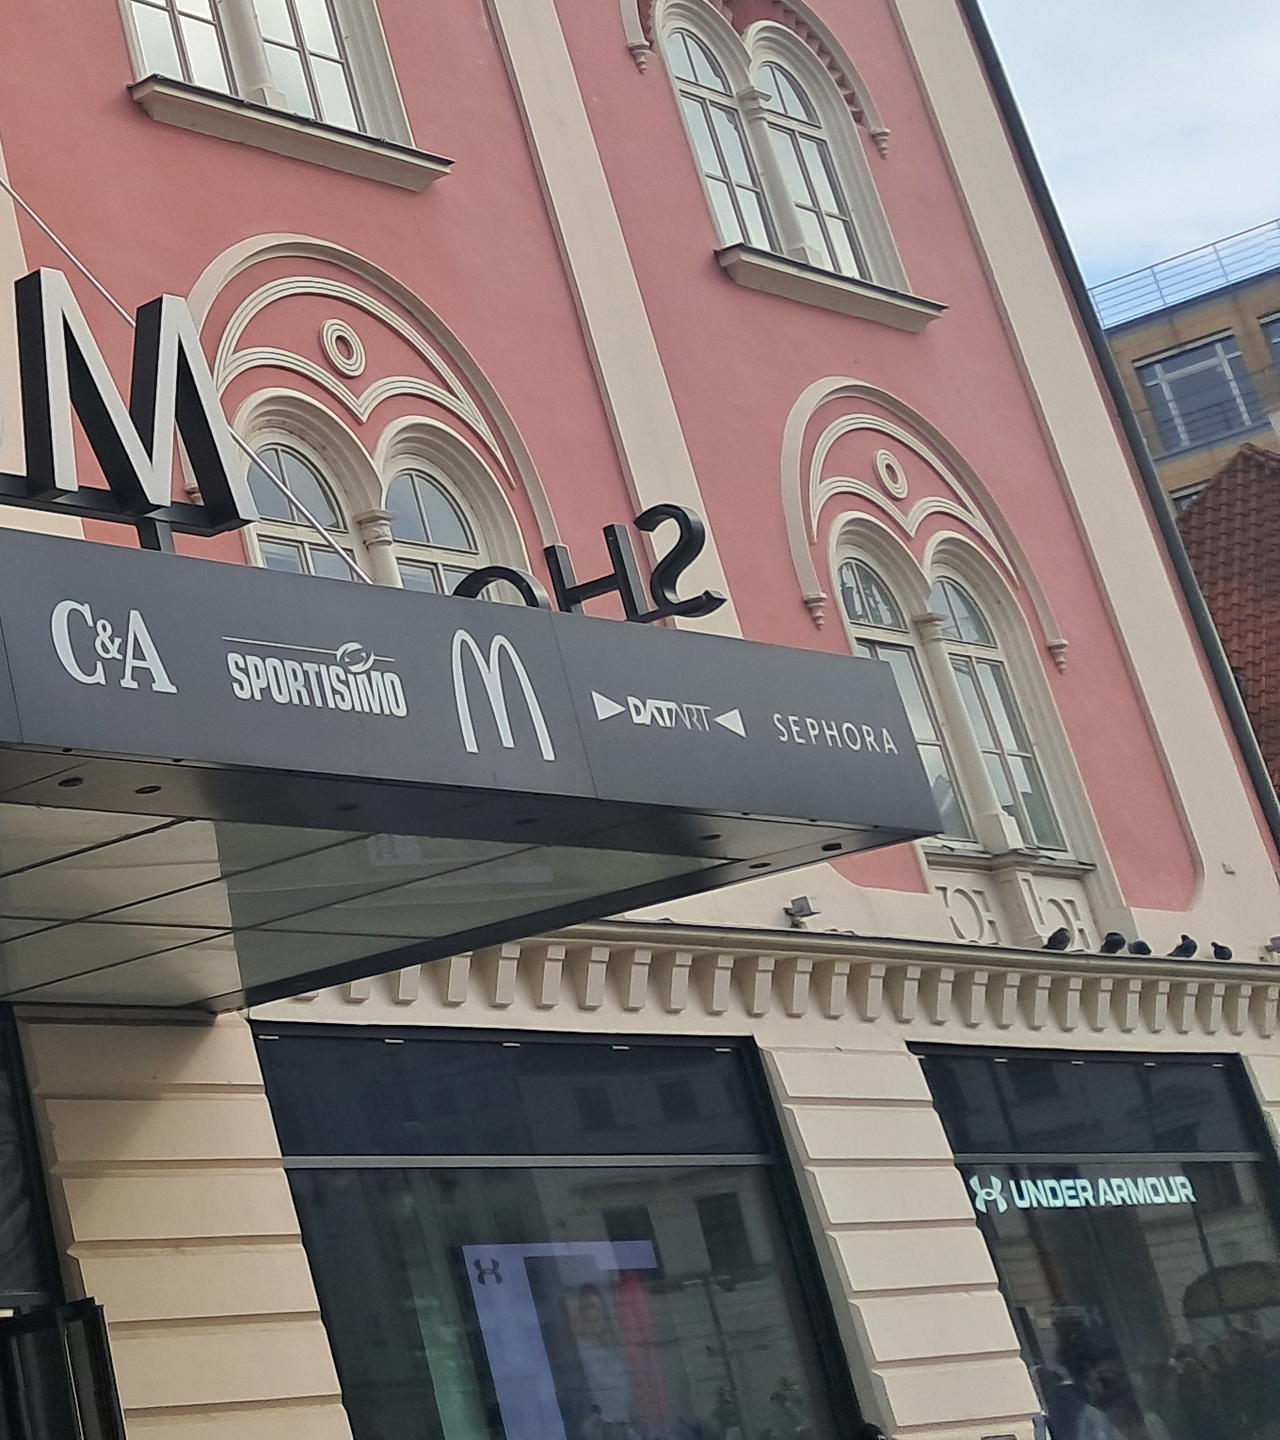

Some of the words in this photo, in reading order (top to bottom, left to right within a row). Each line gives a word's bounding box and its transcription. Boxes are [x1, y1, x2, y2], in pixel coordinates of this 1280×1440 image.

[50, 599, 178, 694] C&A
[226, 651, 408, 718] SPORTISIMO
[627, 695, 711, 732] DATART
[772, 713, 899, 755] SEPHORA
[1009, 1178, 1096, 1209] UNDER
[1097, 1175, 1197, 1208] ARMOUR
